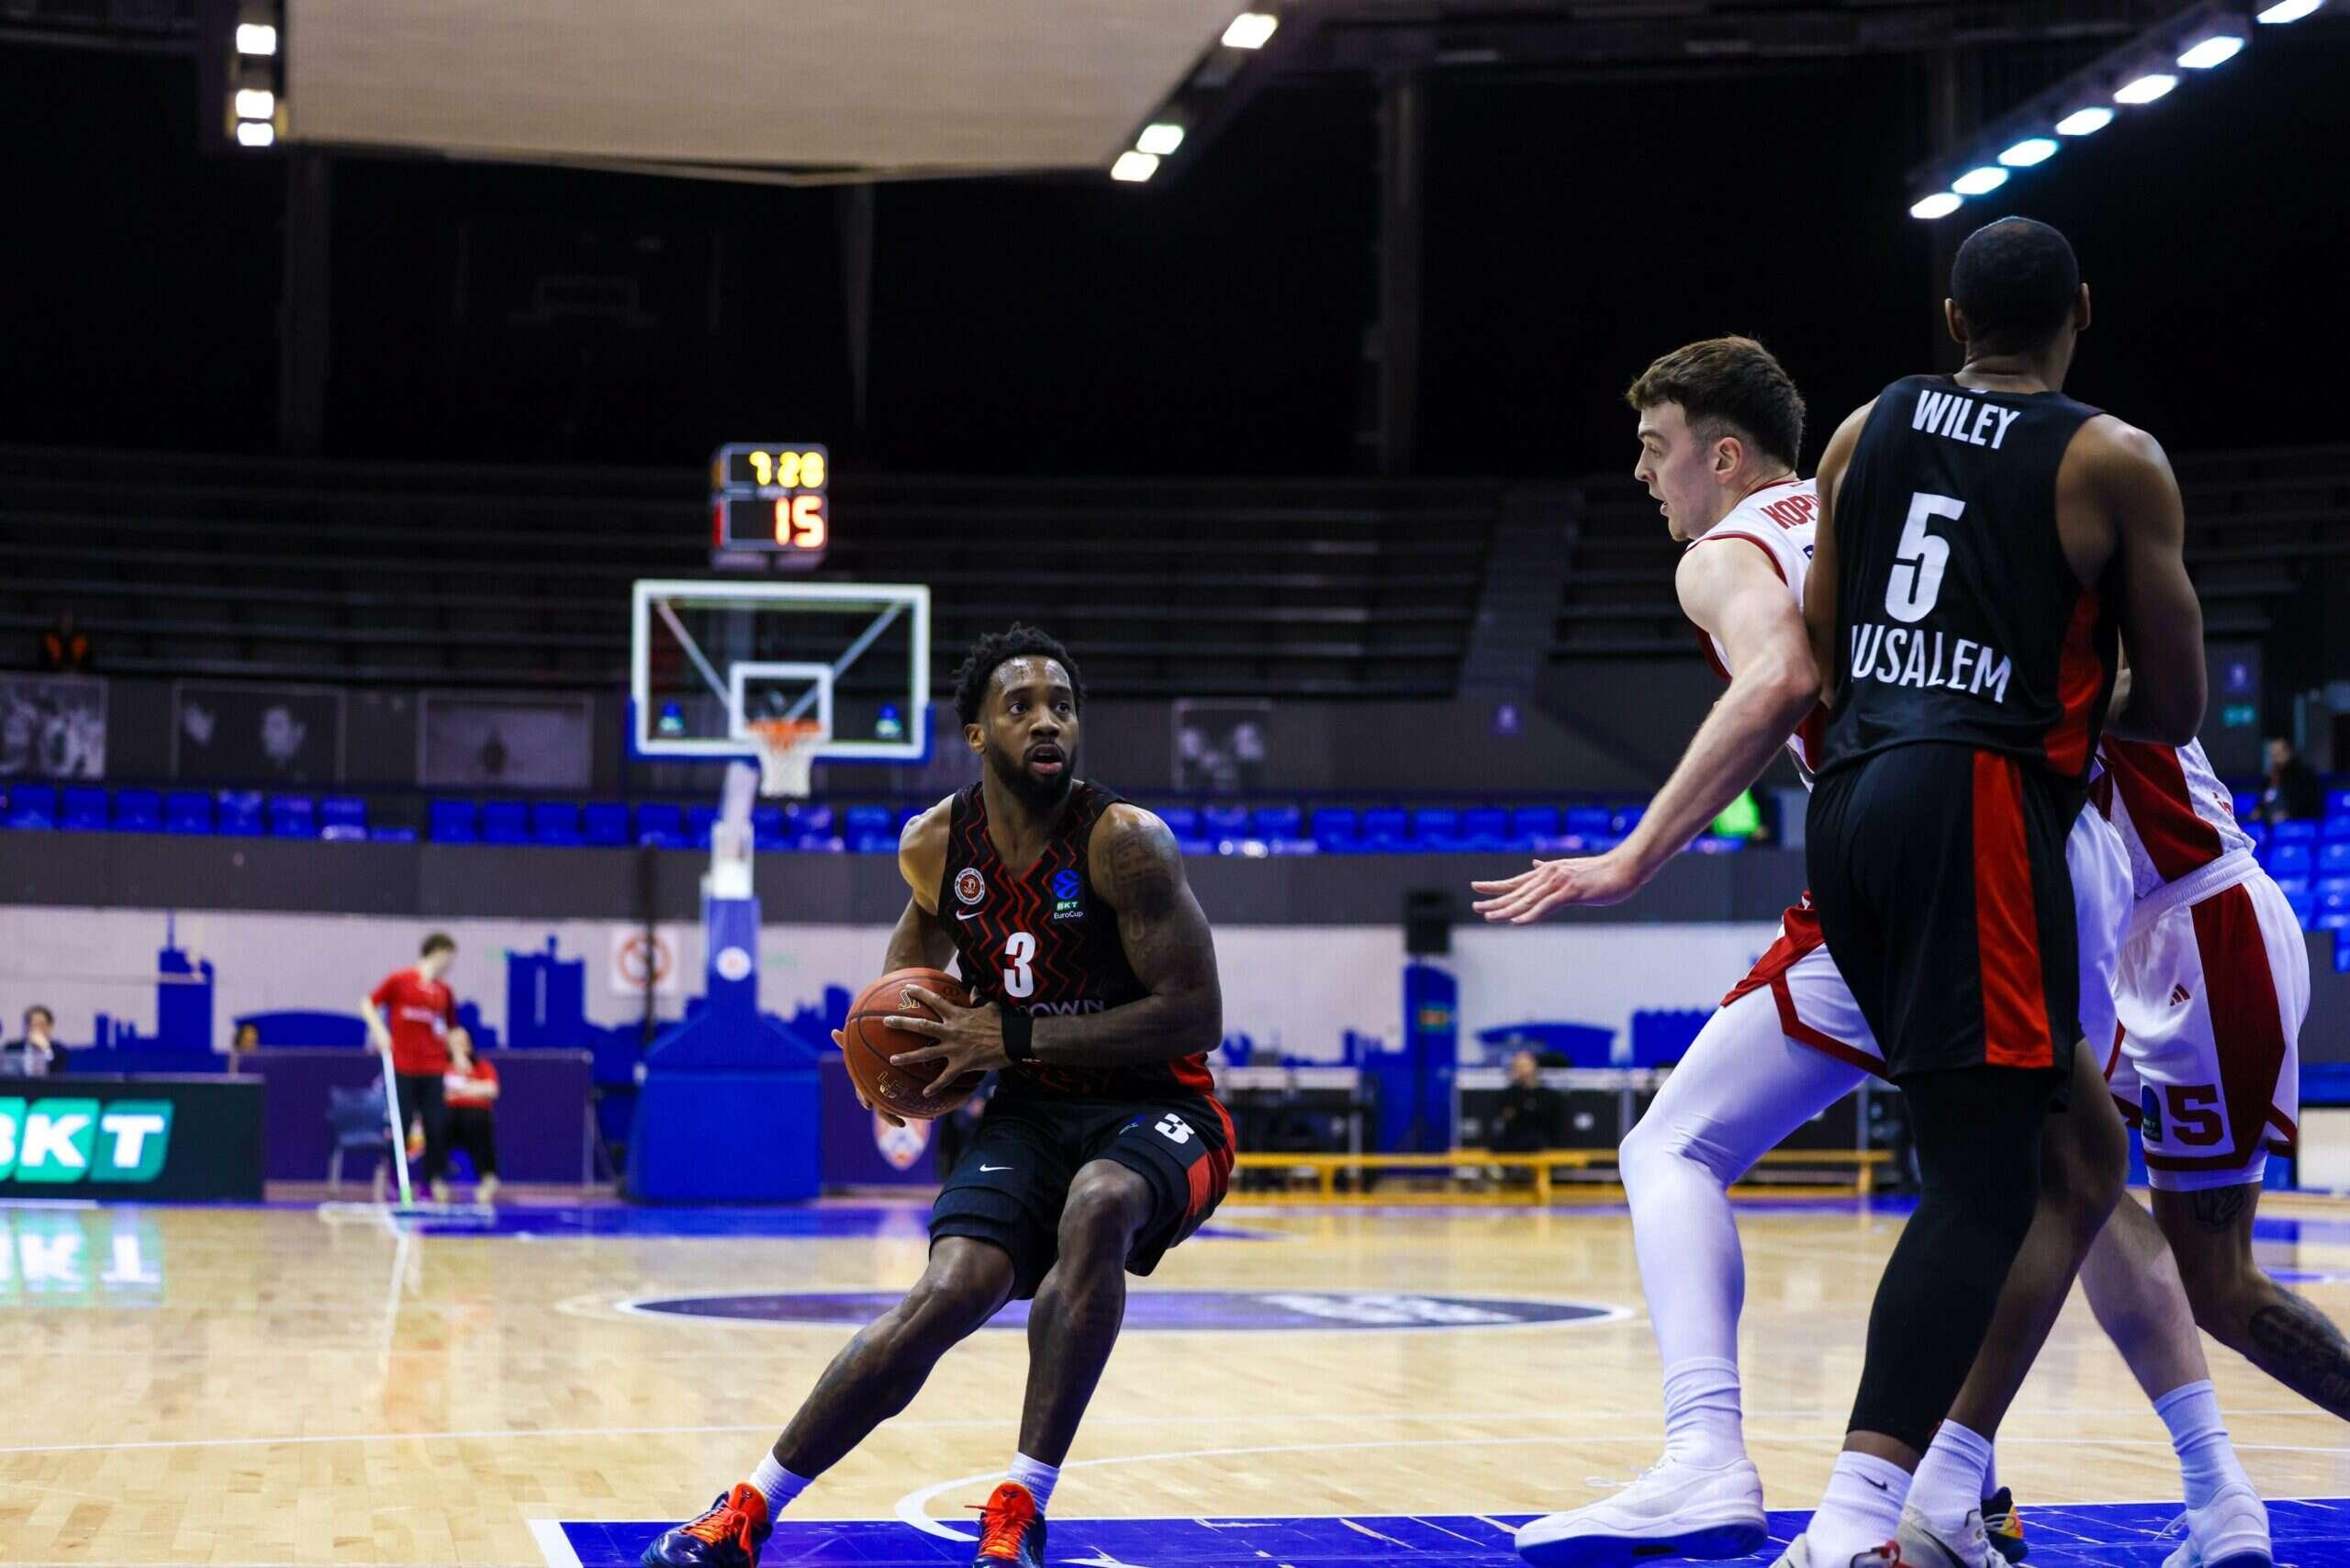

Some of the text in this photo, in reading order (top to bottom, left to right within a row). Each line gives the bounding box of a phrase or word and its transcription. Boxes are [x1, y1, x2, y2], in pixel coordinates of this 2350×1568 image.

[1911, 389, 2021, 450] WILEY
[775, 496, 824, 548] 15
[1885, 491, 1965, 622] 5
[1053, 910, 1083, 920] EuroCup
[1004, 931, 1036, 998] 3
[1154, 1113, 1195, 1144] 3
[2165, 1083, 2224, 1146] 5
